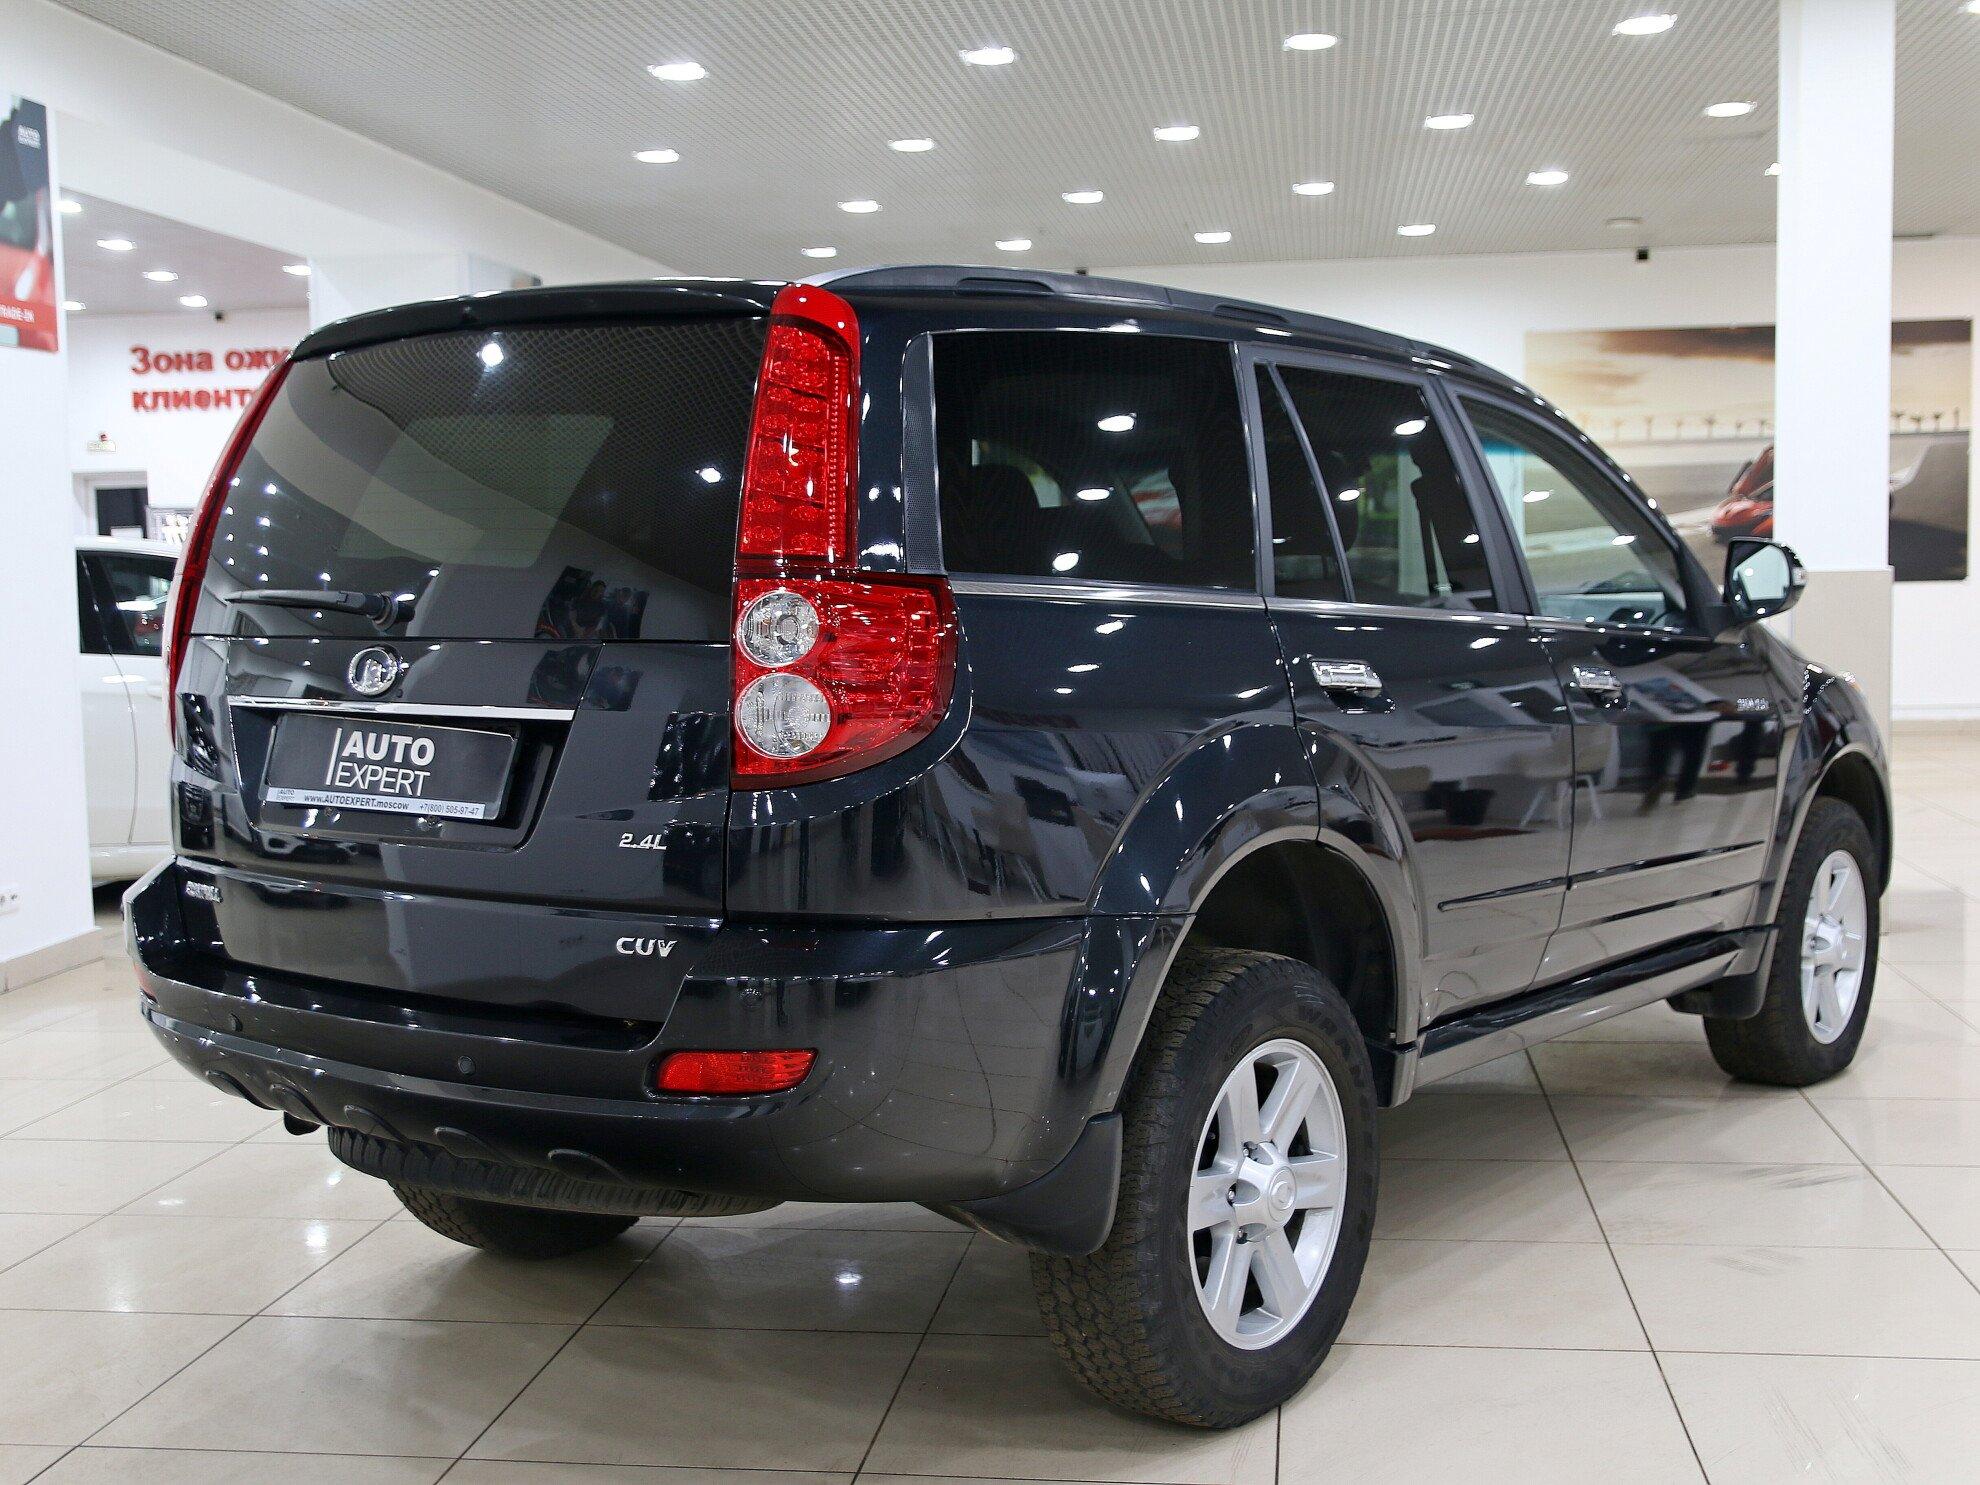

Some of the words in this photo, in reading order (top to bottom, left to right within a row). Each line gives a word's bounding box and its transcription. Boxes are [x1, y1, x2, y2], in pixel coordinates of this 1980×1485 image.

[131, 346, 213, 374] Зона
[132, 388, 256, 411] клиент
[342, 731, 436, 766] AUTO
[334, 761, 431, 797] EXPERT
[304, 794, 409, 811] www.AUTOEXPERT.moscow
[619, 832, 667, 850] 2.4L
[616, 937, 677, 957] CUV
